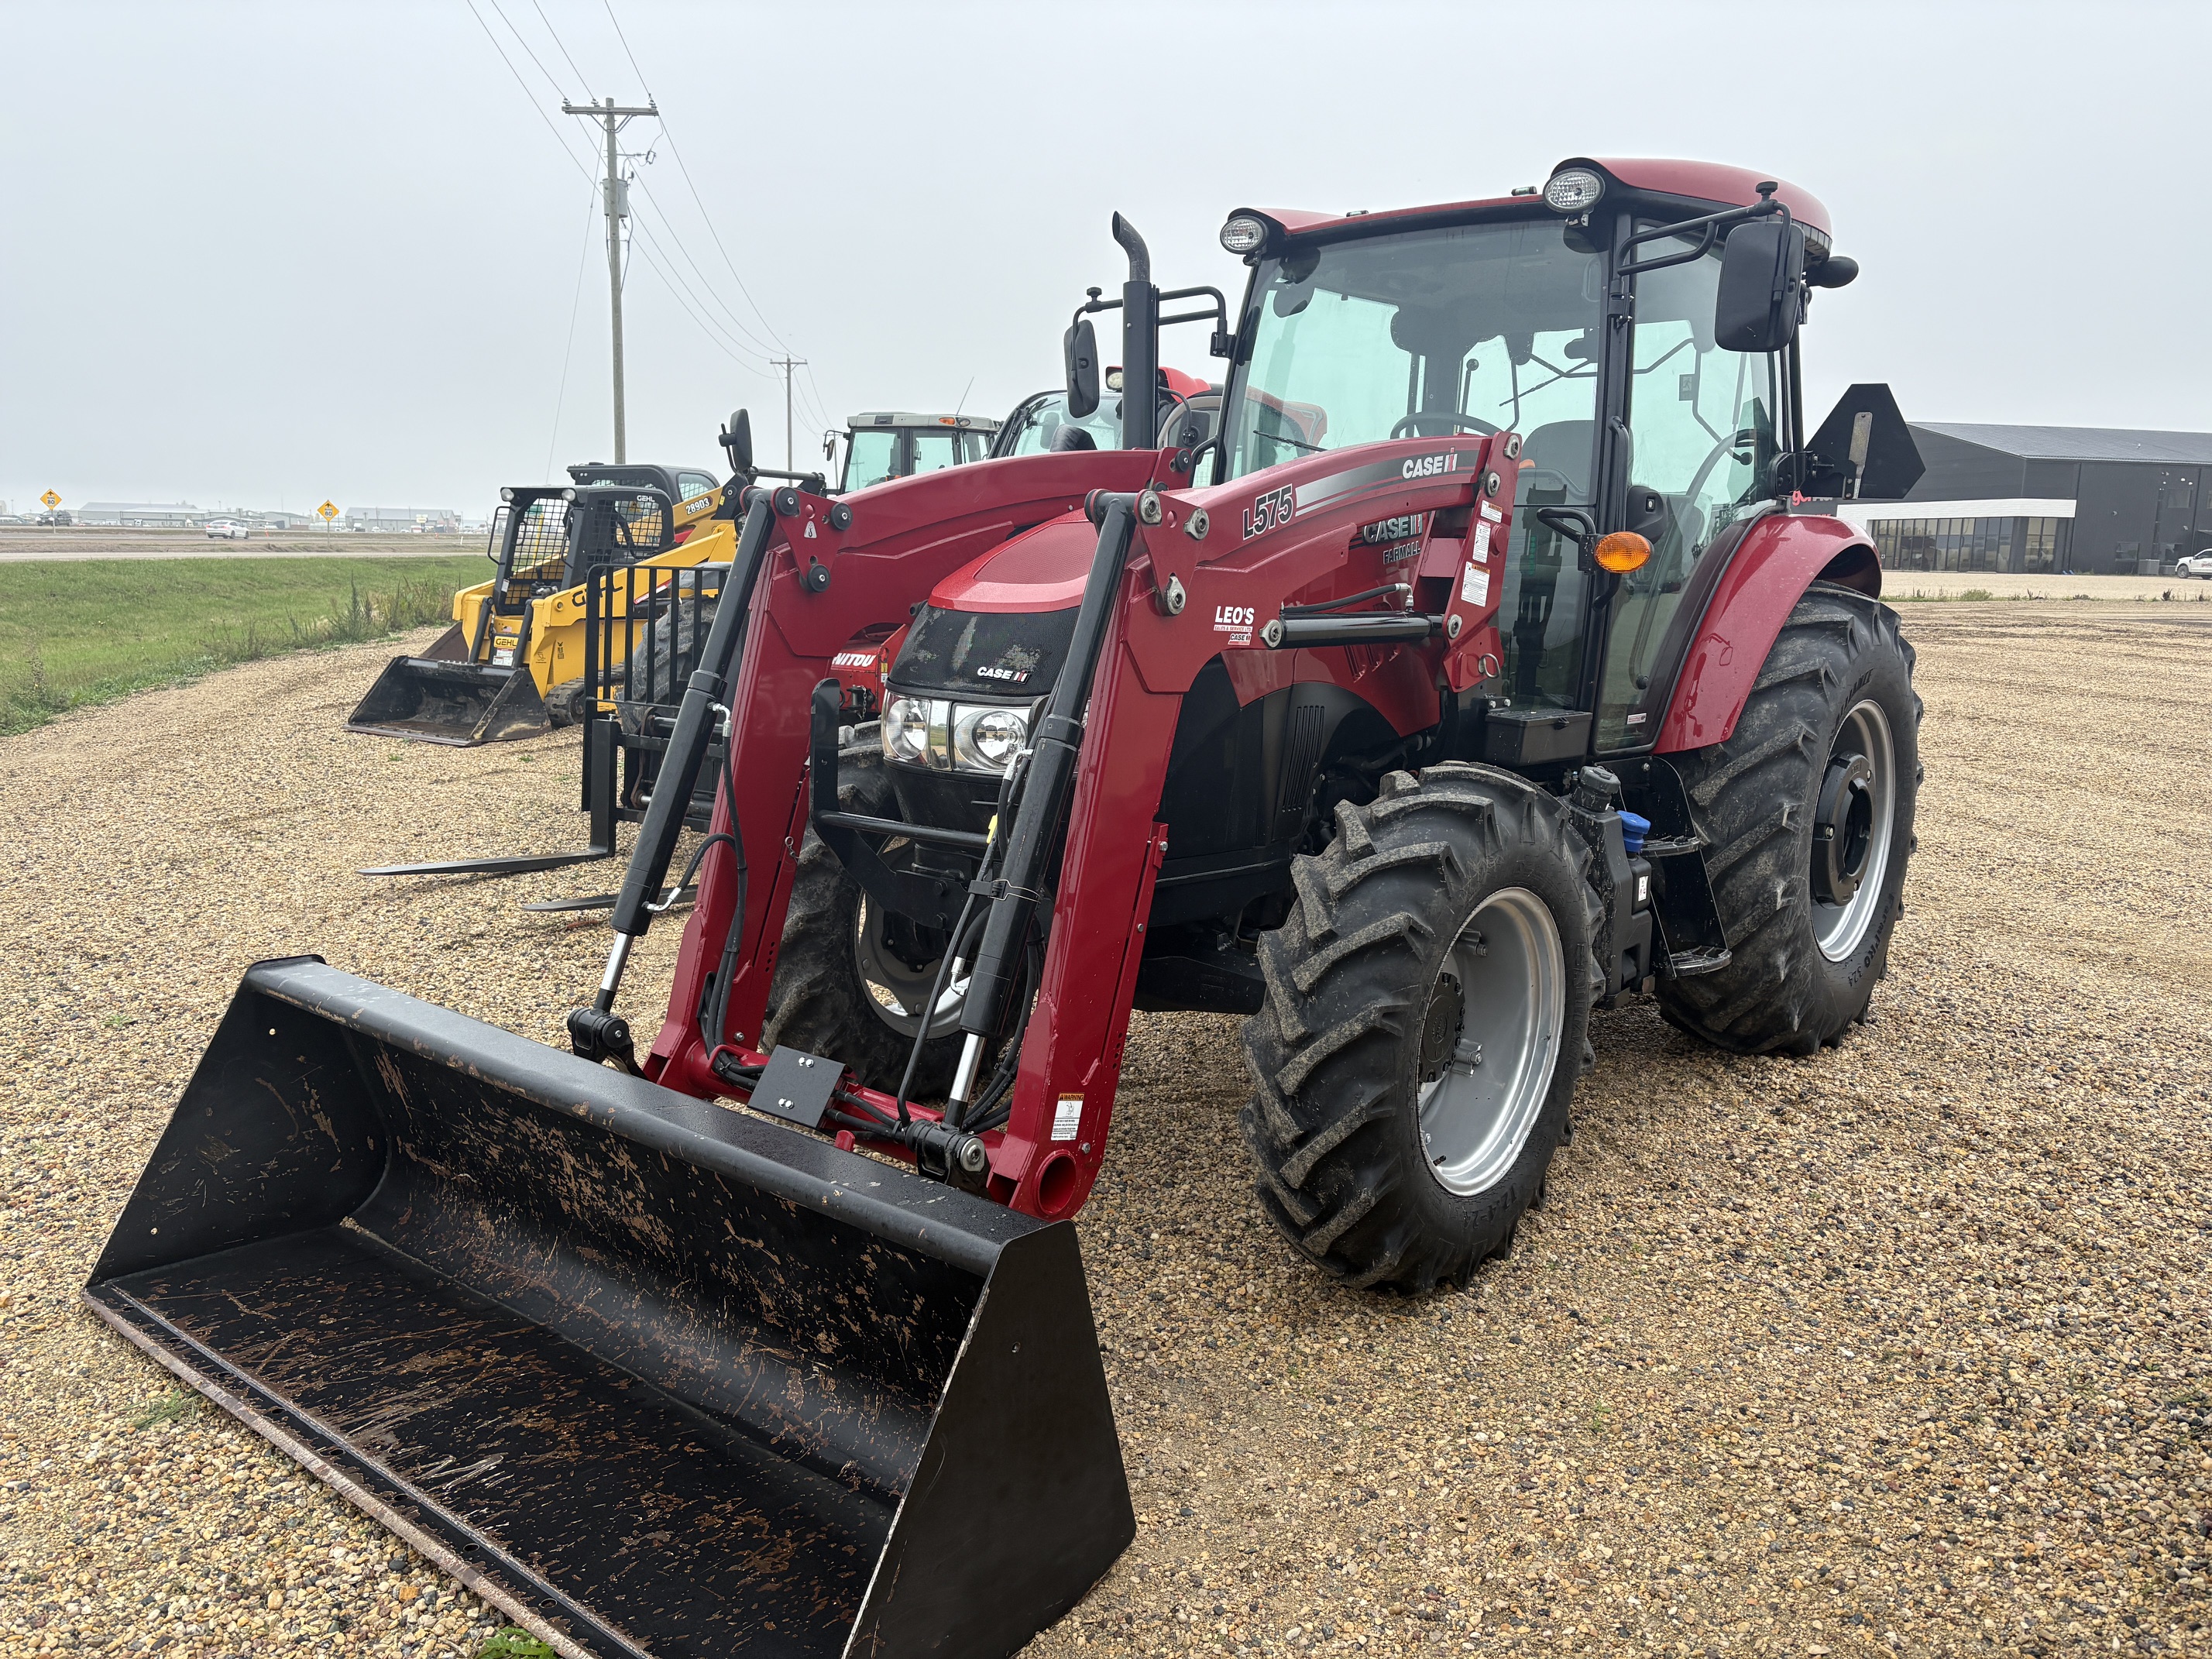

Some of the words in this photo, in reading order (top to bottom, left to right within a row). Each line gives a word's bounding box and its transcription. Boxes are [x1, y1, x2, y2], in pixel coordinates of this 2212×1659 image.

[1402, 457, 1444, 479] CASE
[685, 496, 710, 516] 289D3
[1242, 483, 1293, 541] L575
[1364, 517, 1409, 544] CASE
[1383, 541, 1421, 565] FARMALL
[1214, 606, 1255, 625] LEO'S
[496, 638, 517, 647] GEHL
[977, 666, 1014, 680] CASE
